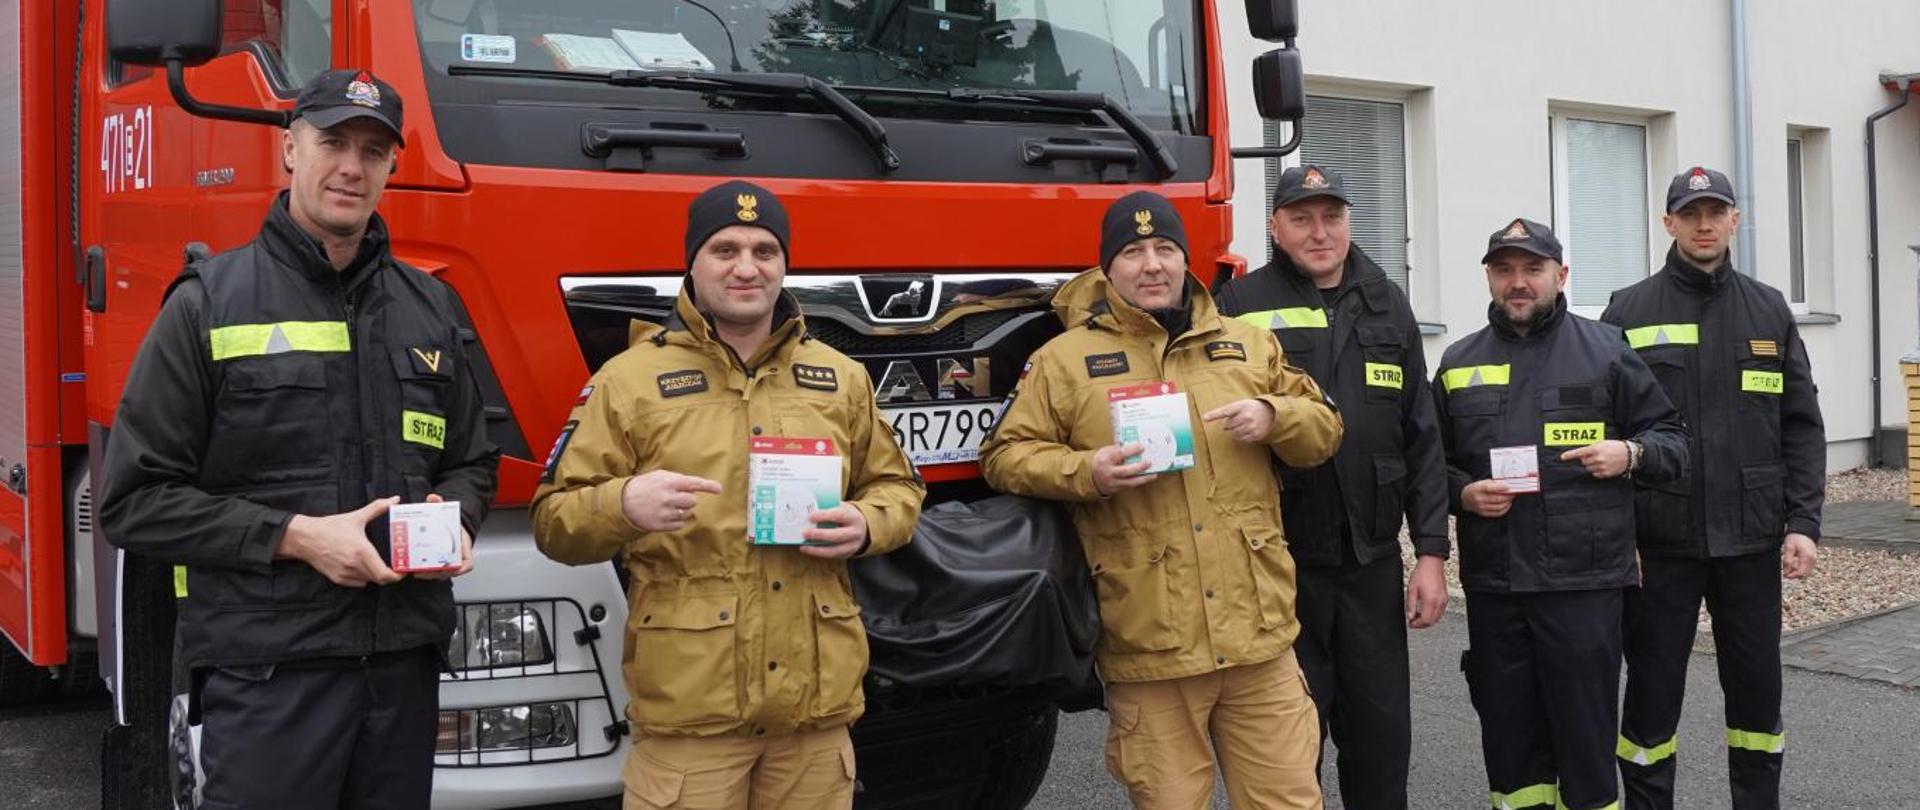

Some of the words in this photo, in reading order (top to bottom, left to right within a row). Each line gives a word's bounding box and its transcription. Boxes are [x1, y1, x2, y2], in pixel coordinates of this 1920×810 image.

[101, 112, 124, 193] 471
[134, 105, 152, 189] 21
[875, 358, 991, 401] AN
